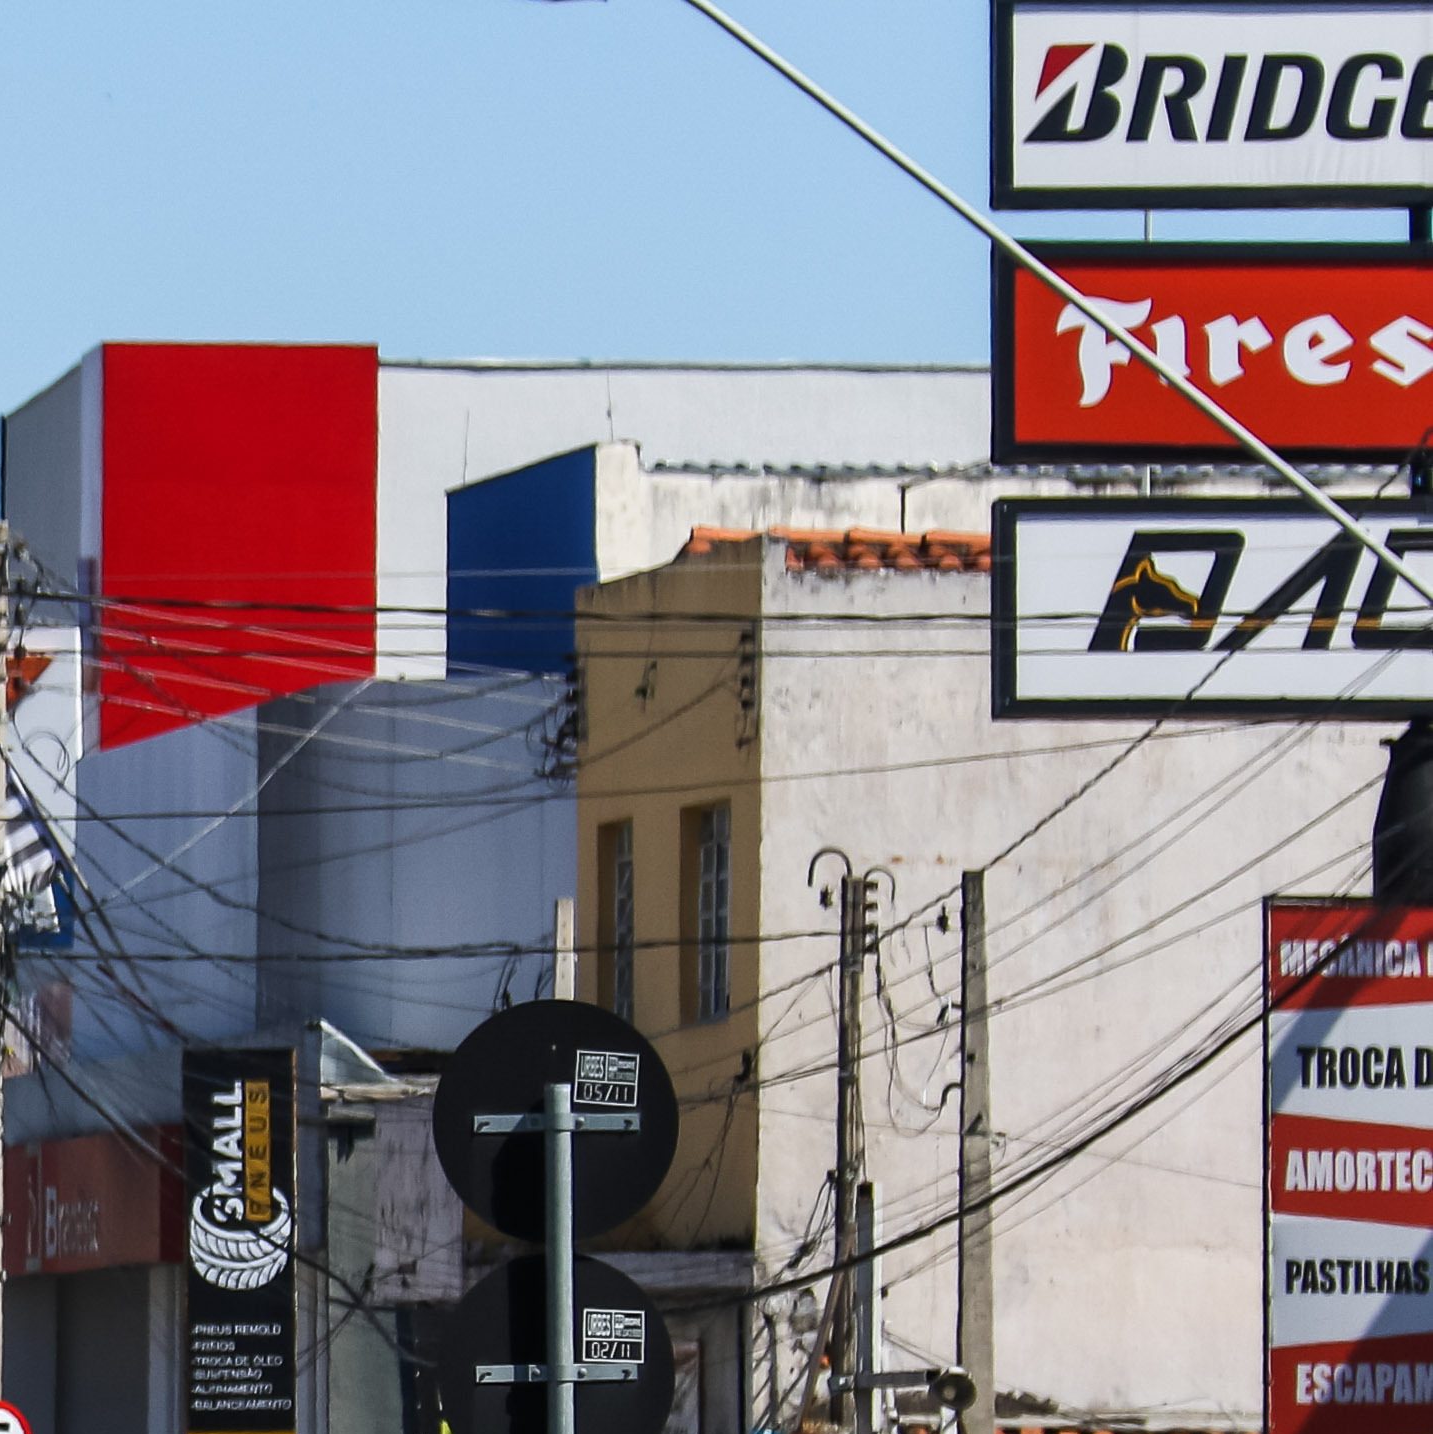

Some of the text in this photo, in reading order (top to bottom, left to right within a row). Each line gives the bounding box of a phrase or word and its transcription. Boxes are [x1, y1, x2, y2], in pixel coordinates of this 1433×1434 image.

[1296, 1045, 1407, 1089] TROCA
[583, 1083, 628, 1102] 05/11
[212, 1080, 244, 1222] SMALL
[1284, 1148, 1433, 1193] AMORTEC
[1285, 1259, 1431, 1295] PASTILHAS
[591, 1341, 631, 1359] 02/11
